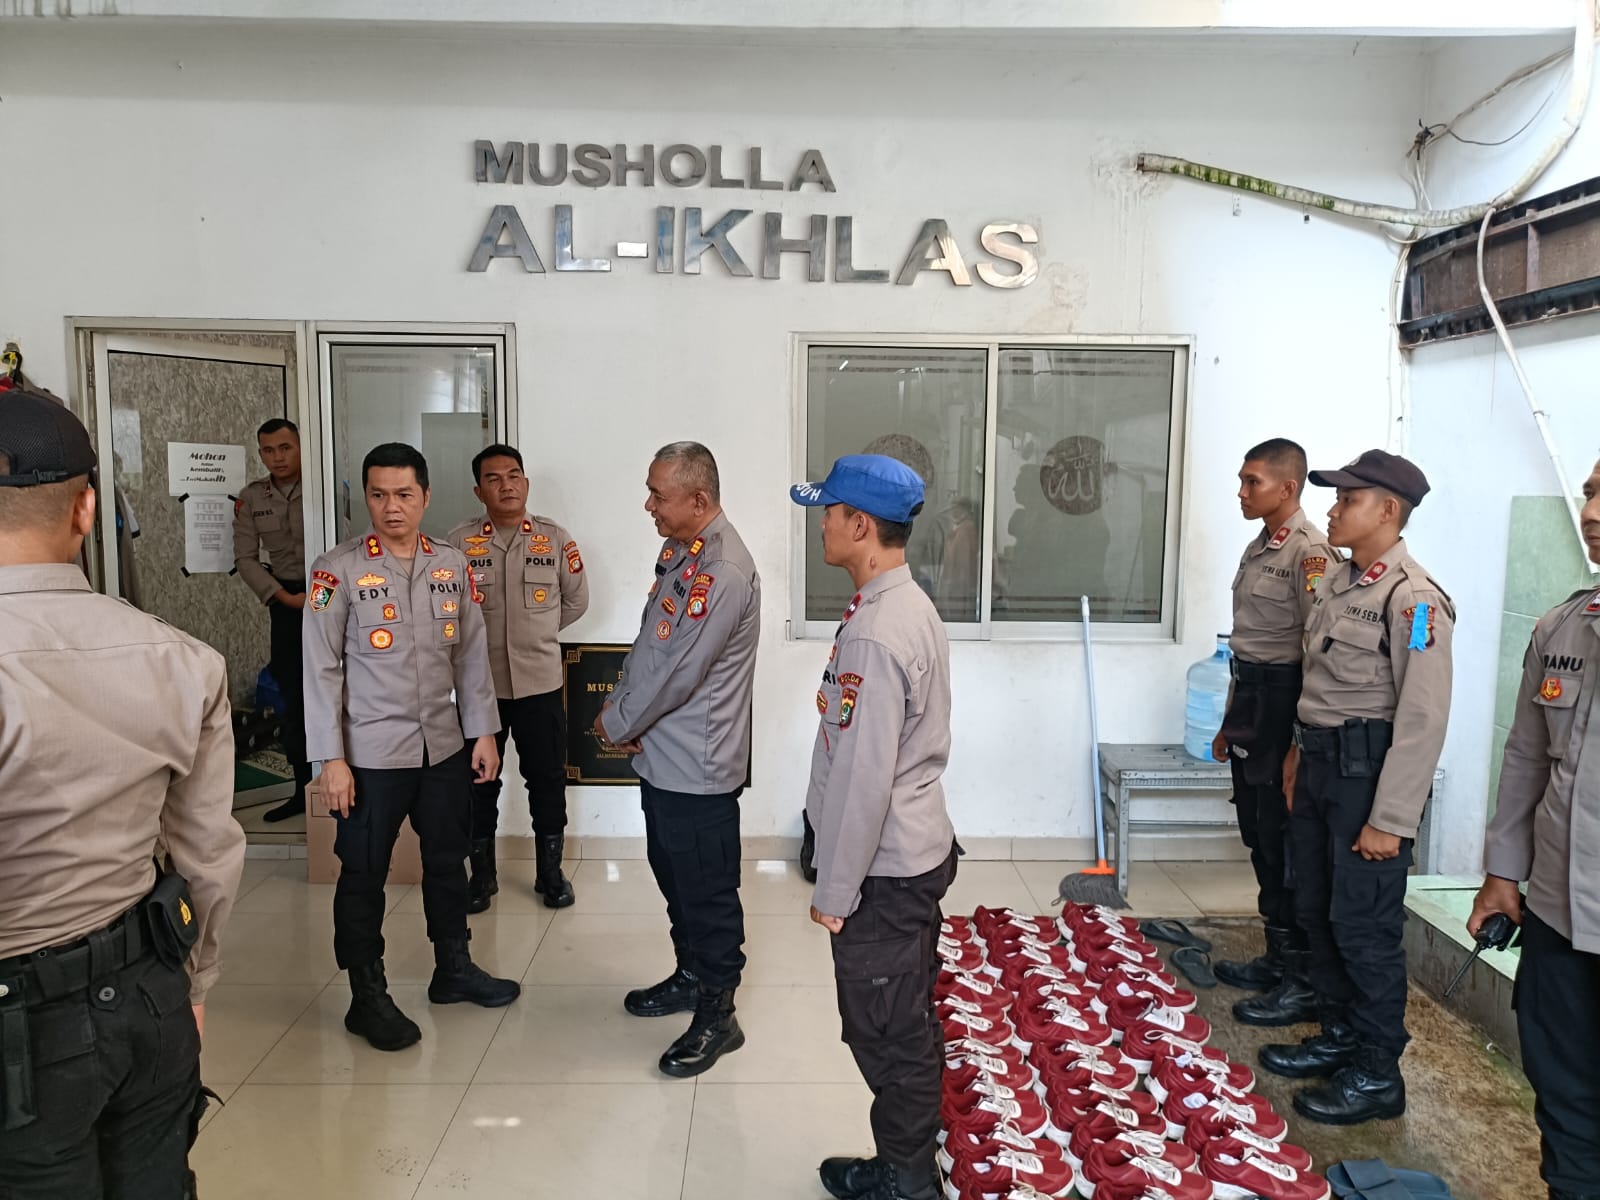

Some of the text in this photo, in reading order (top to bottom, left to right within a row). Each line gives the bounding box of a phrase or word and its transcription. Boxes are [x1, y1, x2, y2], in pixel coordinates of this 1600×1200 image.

[475, 139, 837, 193] MUSHOLLA
[466, 204, 1039, 289] AL-IKHLAS
[469, 558, 493, 568] GUS
[525, 557, 555, 567] POLRI
[317, 571, 334, 583] SPN
[359, 586, 390, 601] EDY
[429, 583, 462, 594] POLRI
